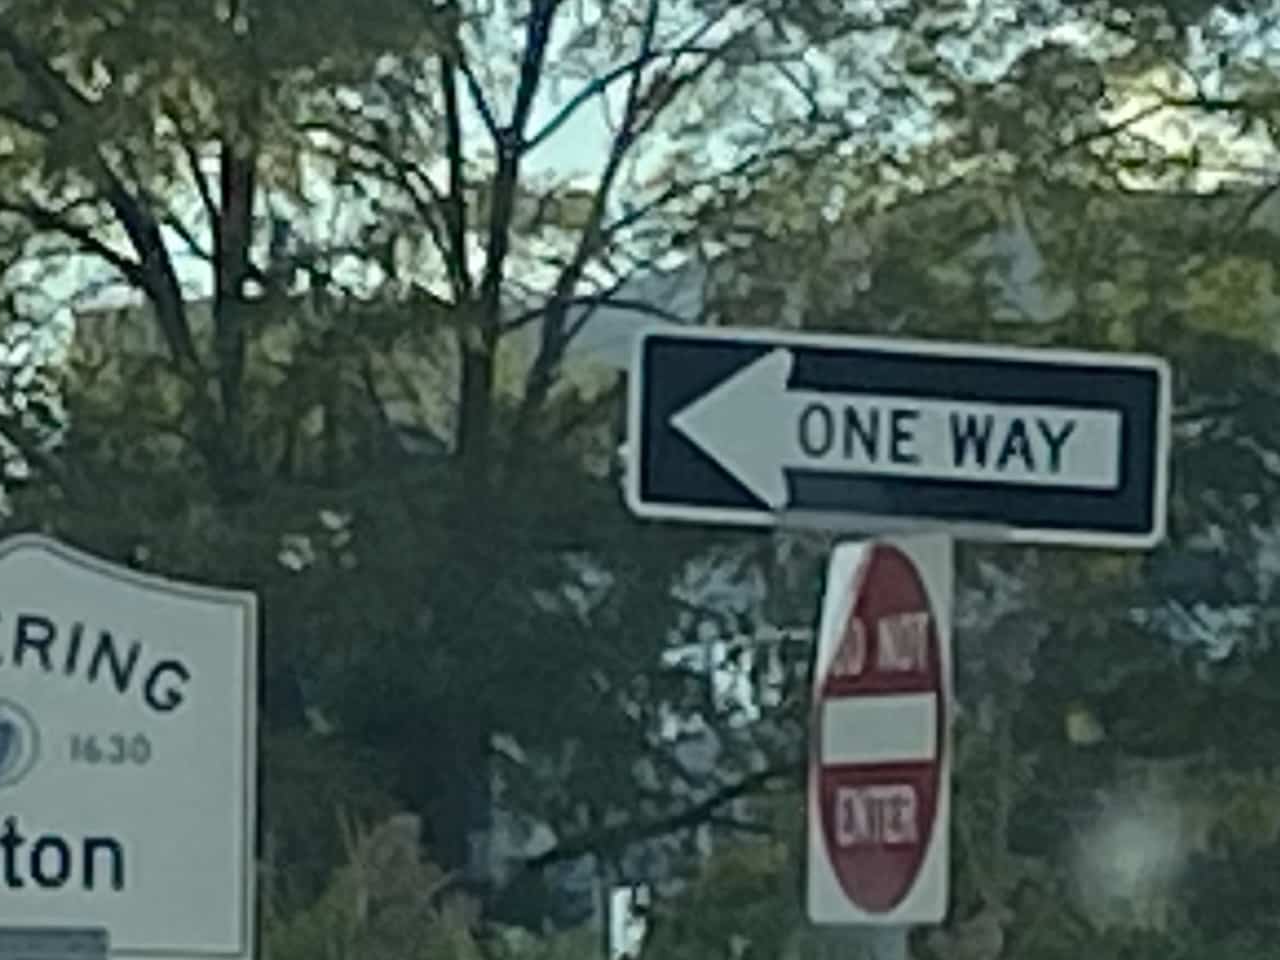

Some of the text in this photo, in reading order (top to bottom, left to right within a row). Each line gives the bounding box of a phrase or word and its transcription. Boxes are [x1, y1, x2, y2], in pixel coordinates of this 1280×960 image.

[798, 404, 1076, 472] ONE WAY
[70, 733, 152, 764] 1630
[835, 785, 918, 846] ENTER
